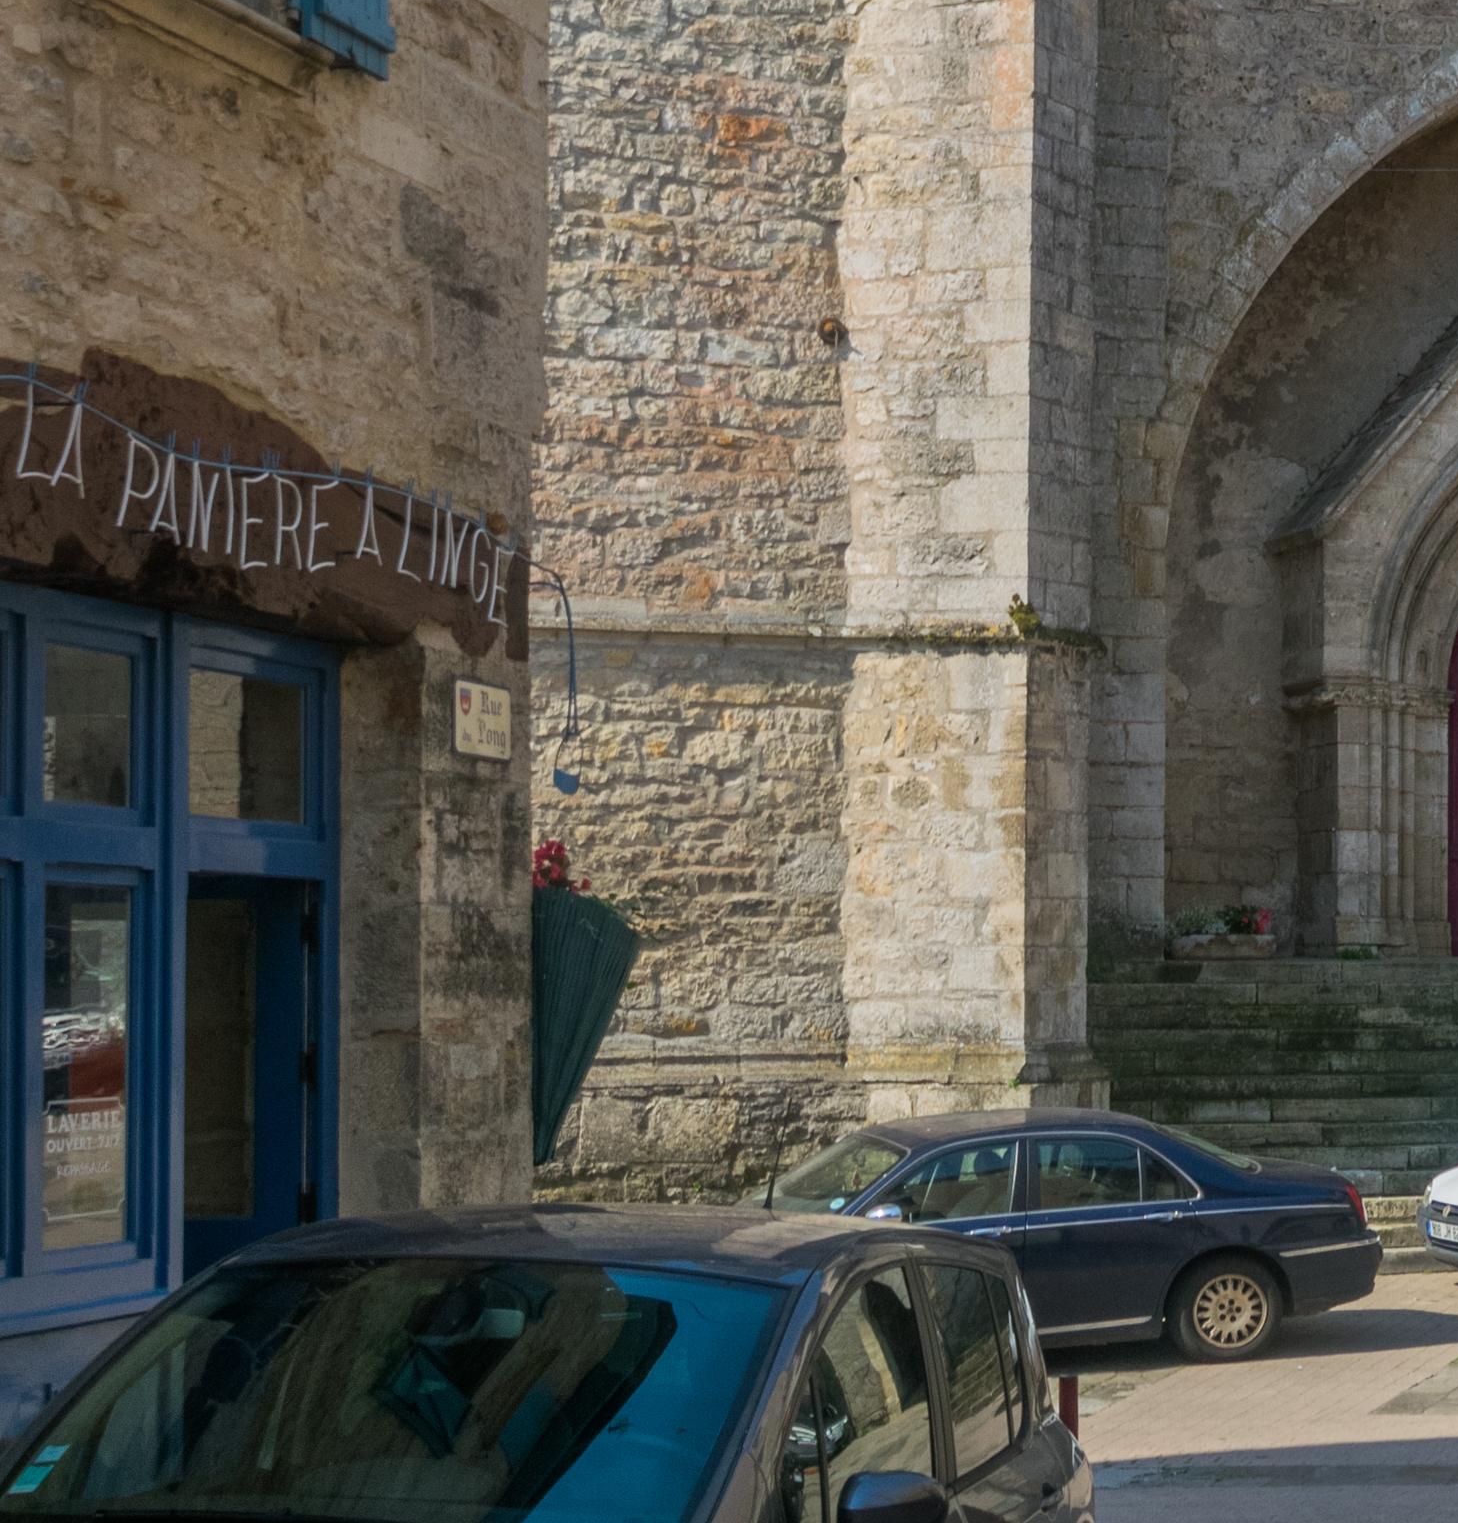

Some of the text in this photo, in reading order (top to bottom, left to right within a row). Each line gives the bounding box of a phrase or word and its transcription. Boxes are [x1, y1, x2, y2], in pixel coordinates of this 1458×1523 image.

[16, 383, 516, 629] LA PANIERE A LINGE
[480, 690, 503, 717] Rue
[47, 1109, 121, 1133] LAVERIE
